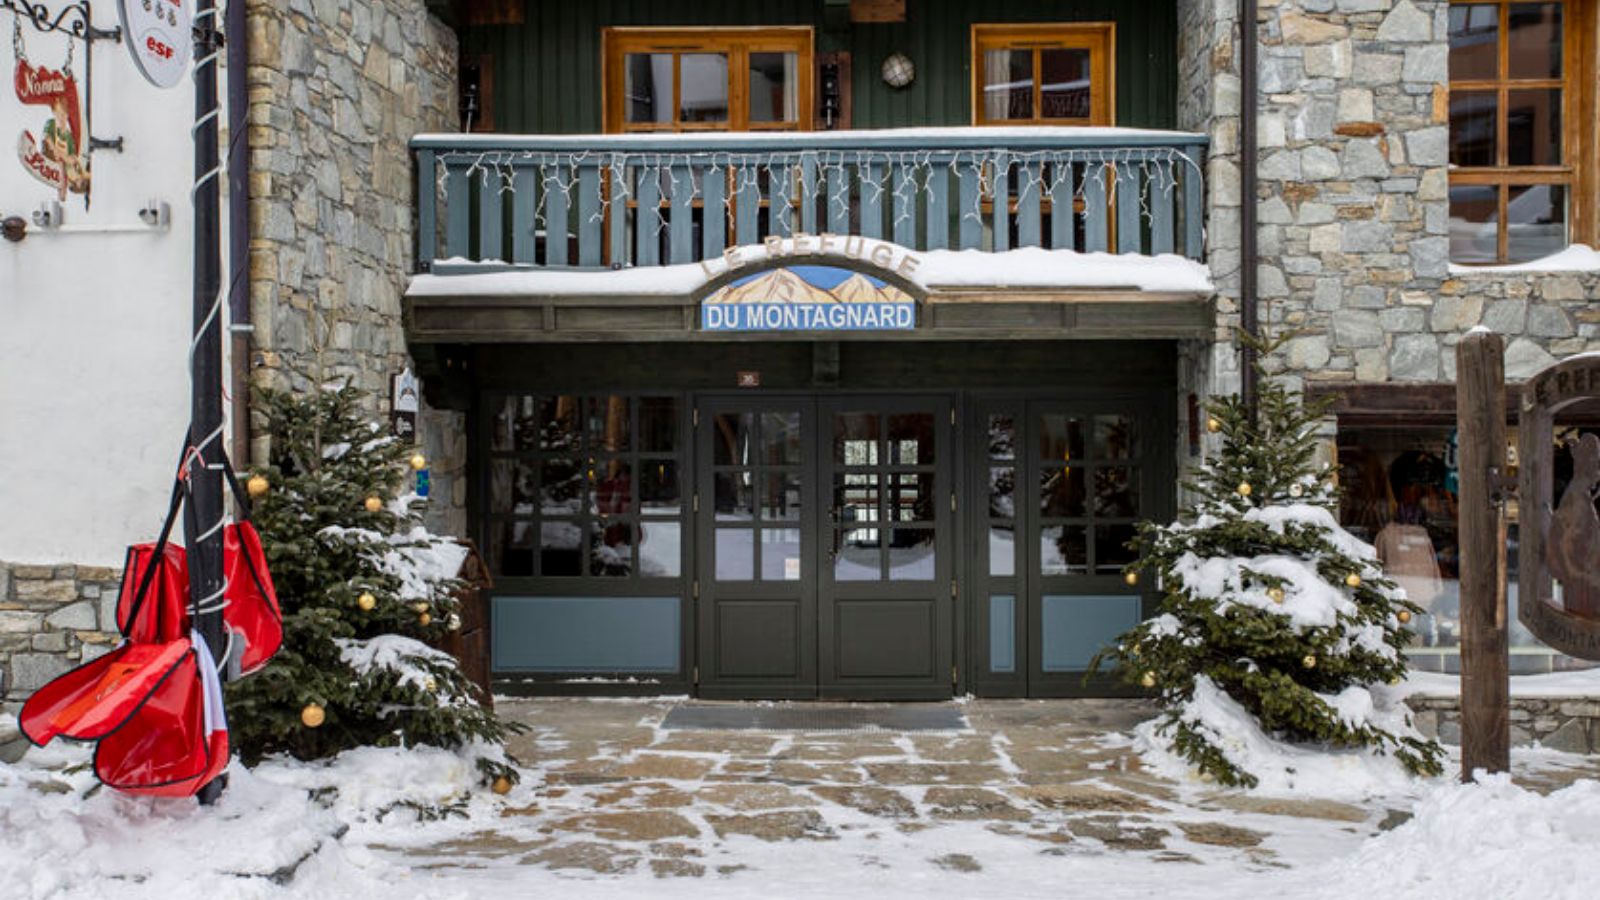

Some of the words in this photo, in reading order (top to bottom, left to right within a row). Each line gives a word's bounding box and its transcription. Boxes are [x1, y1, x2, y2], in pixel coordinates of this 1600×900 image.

[146, 36, 174, 60] esf
[20, 69, 65, 98] Nonna
[700, 245, 746, 280] LE
[764, 232, 921, 280] REFUGE
[707, 305, 738, 328] DU
[747, 304, 912, 328] MONTAGNARD
